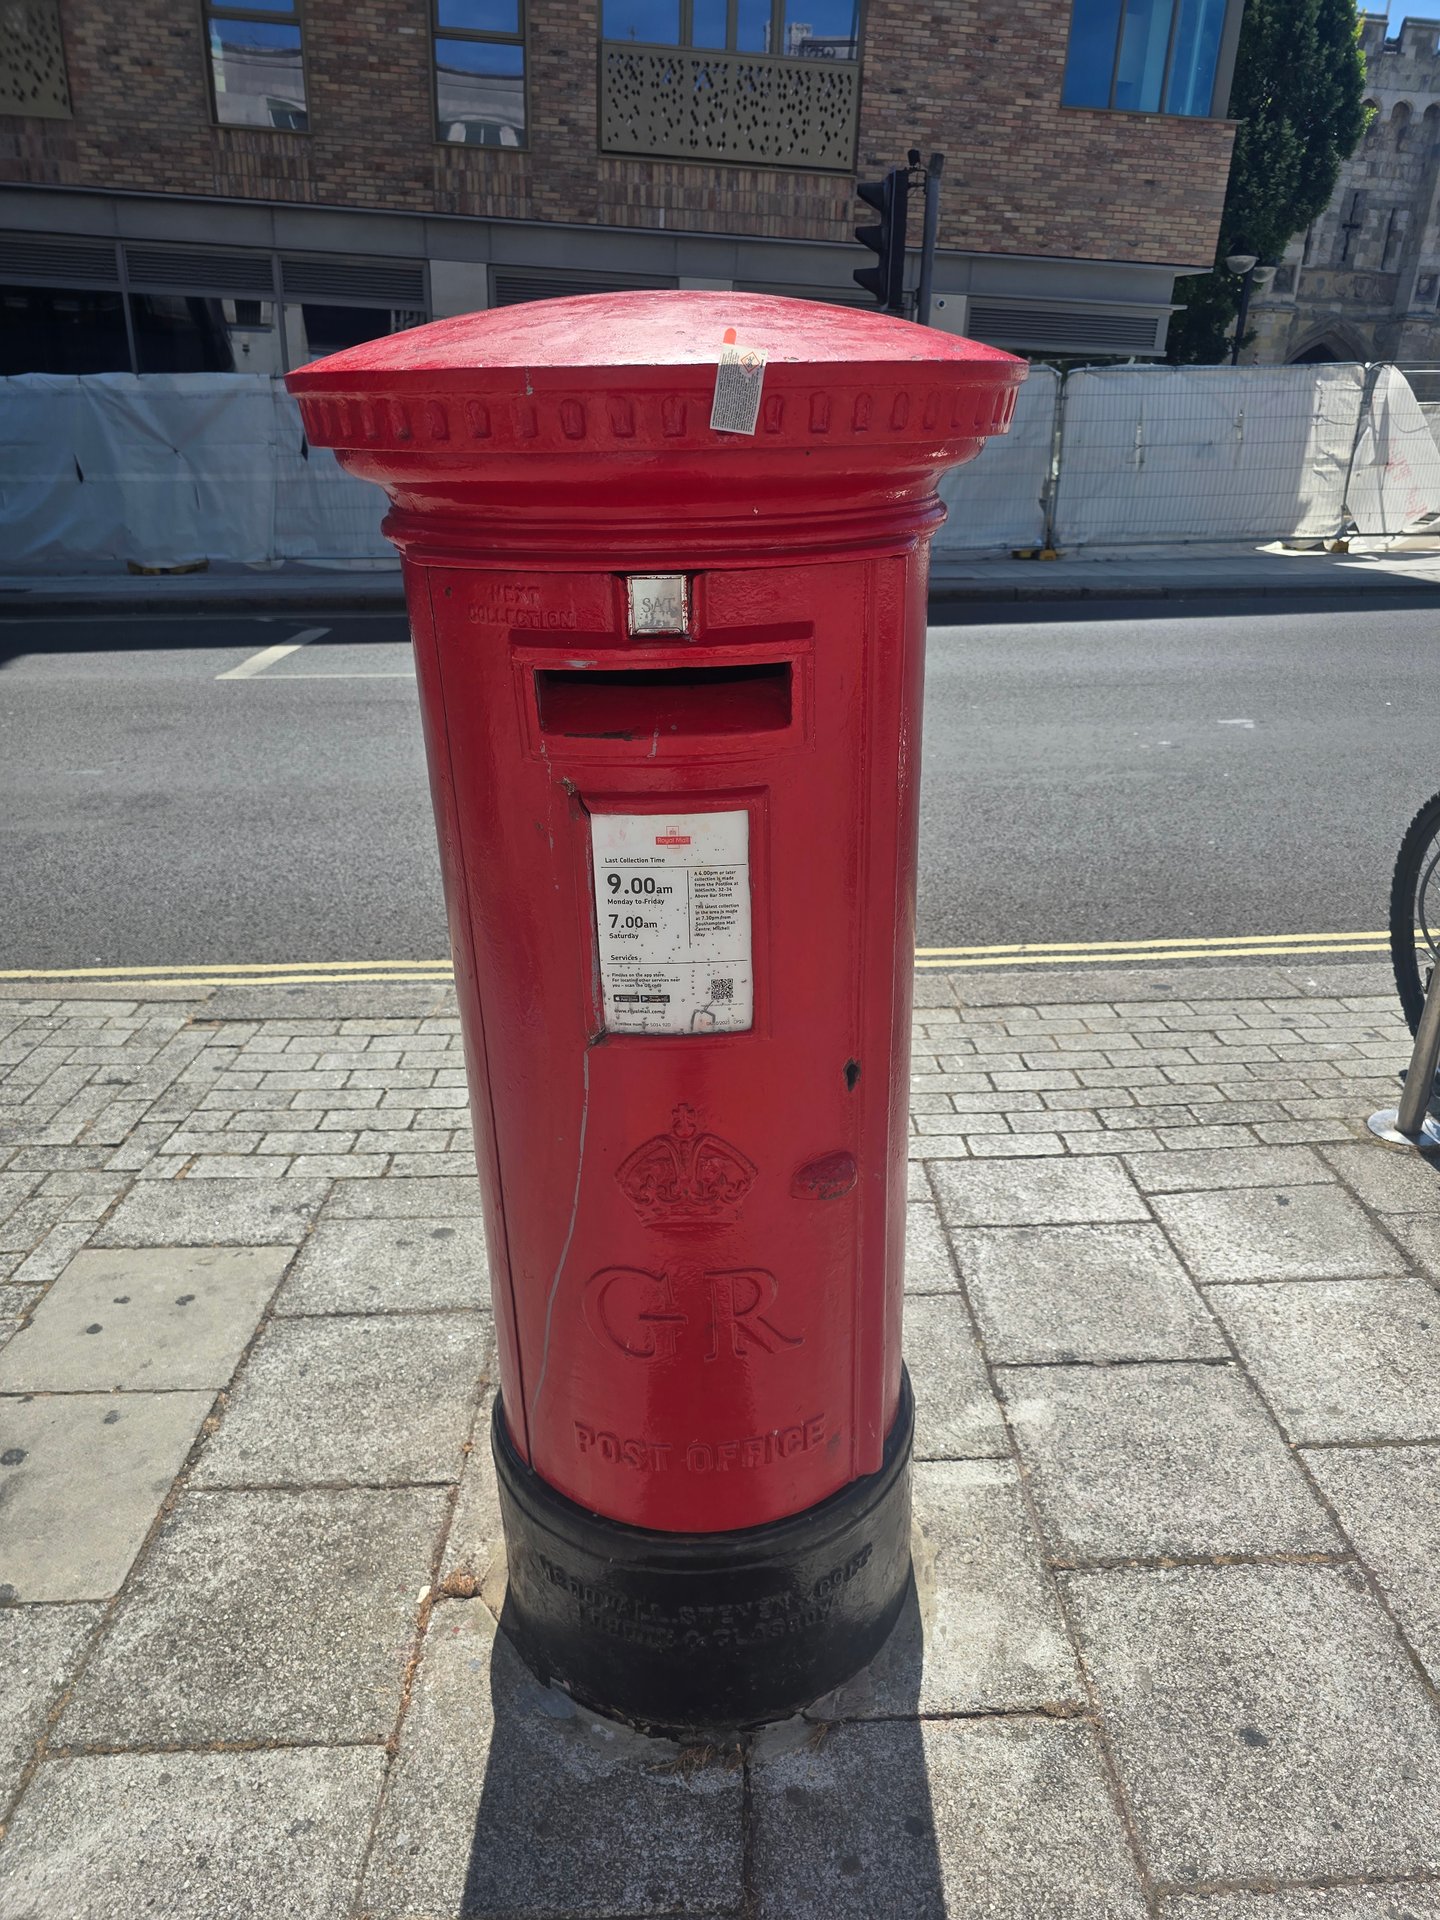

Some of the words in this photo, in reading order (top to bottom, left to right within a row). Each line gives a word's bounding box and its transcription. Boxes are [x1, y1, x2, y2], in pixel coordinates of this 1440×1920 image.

[642, 597, 676, 614] SAT
[468, 604, 577, 628] COLLECTION
[607, 874, 672, 894] 9.00am
[608, 914, 658, 928] 7.00am
[573, 1420, 672, 1472] POST
[685, 1412, 826, 1472] OFFICE
